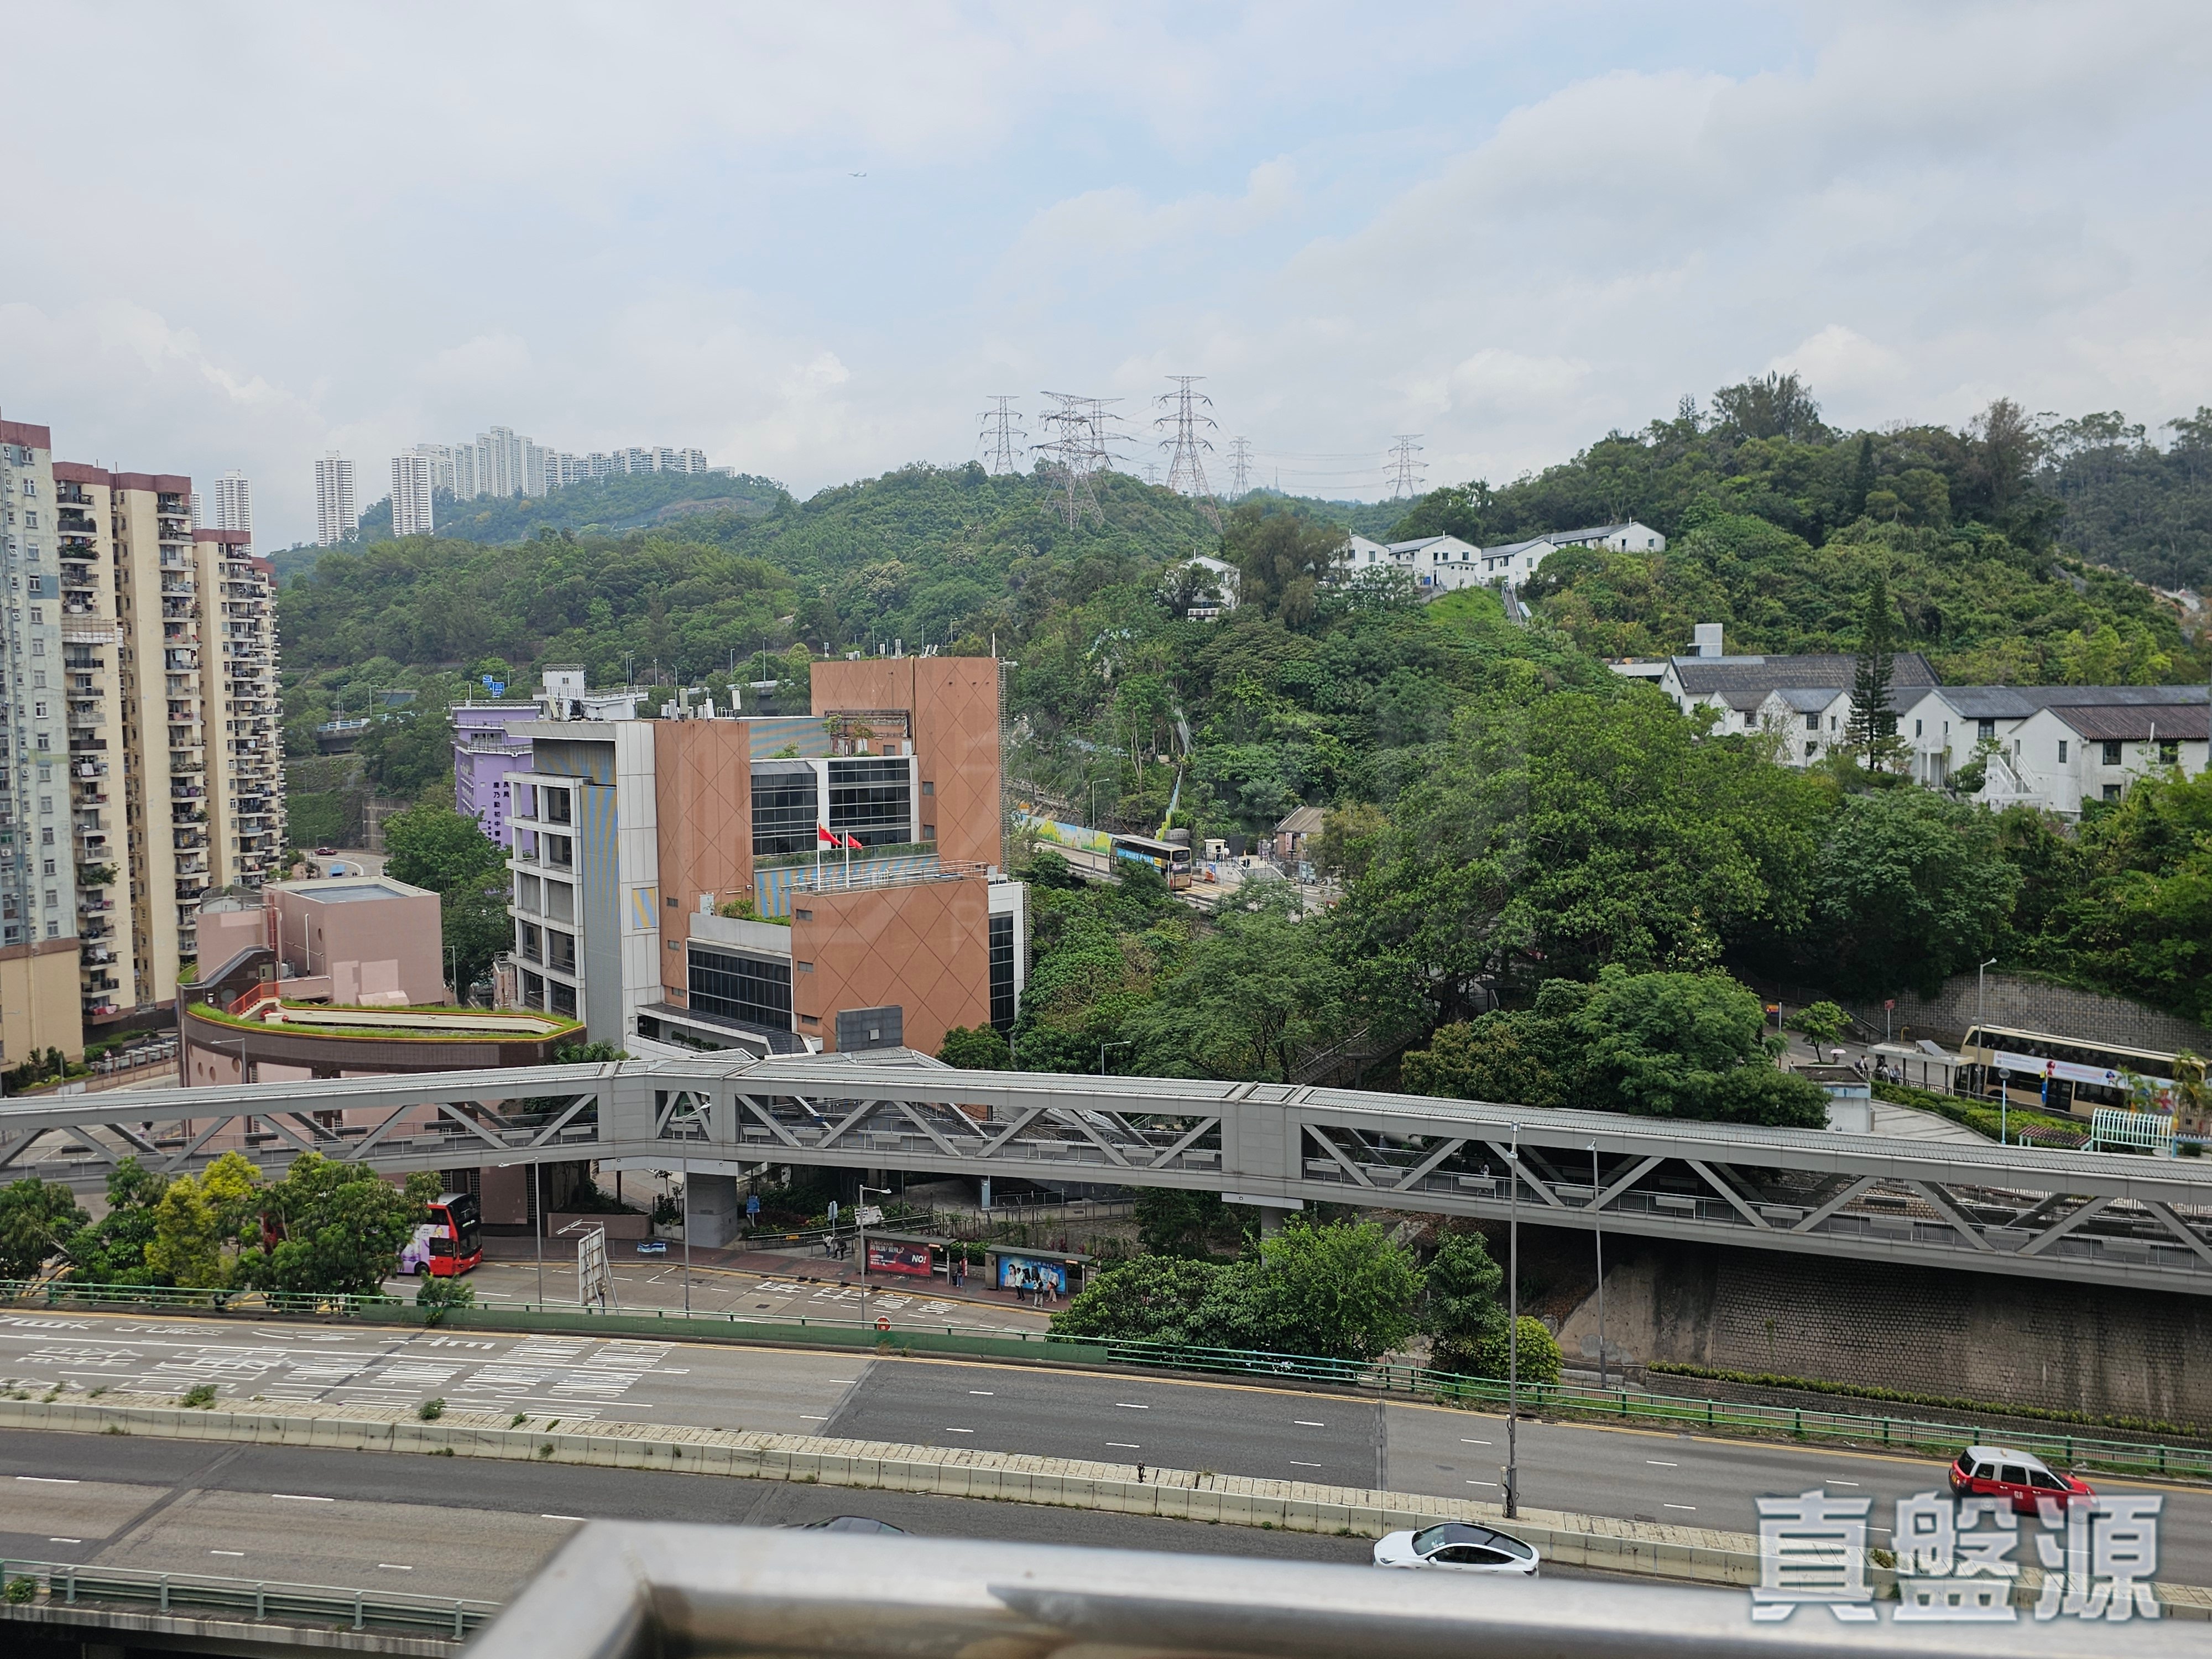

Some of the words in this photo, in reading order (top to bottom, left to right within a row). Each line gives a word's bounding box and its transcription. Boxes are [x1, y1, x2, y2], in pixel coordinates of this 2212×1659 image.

[912, 1254, 927, 1264] NO!
[872, 1293, 913, 1310] STOP
[918, 1301, 958, 1315] BUS
